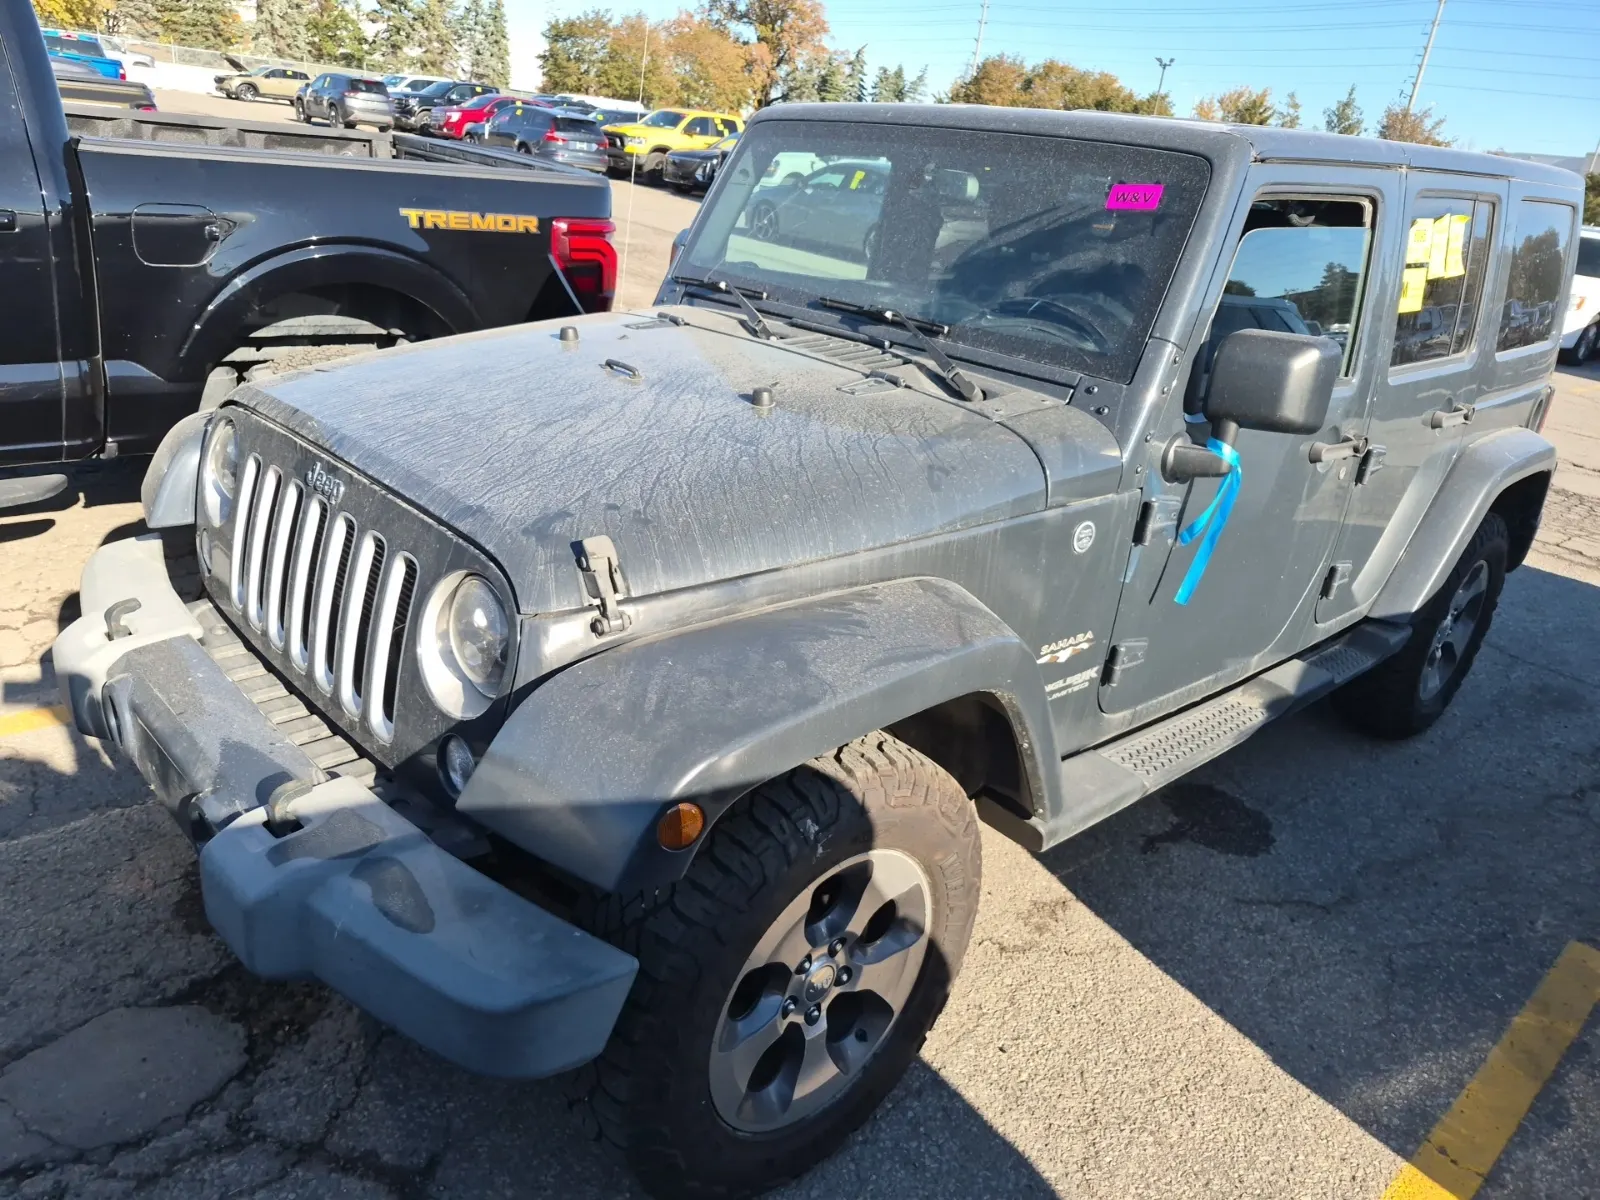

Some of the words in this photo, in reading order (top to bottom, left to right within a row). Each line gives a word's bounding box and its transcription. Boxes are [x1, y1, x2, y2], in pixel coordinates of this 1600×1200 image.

[398, 207, 541, 234] TREMOR
[305, 461, 345, 506] Jeep
[1040, 630, 1094, 656] SAHARA
